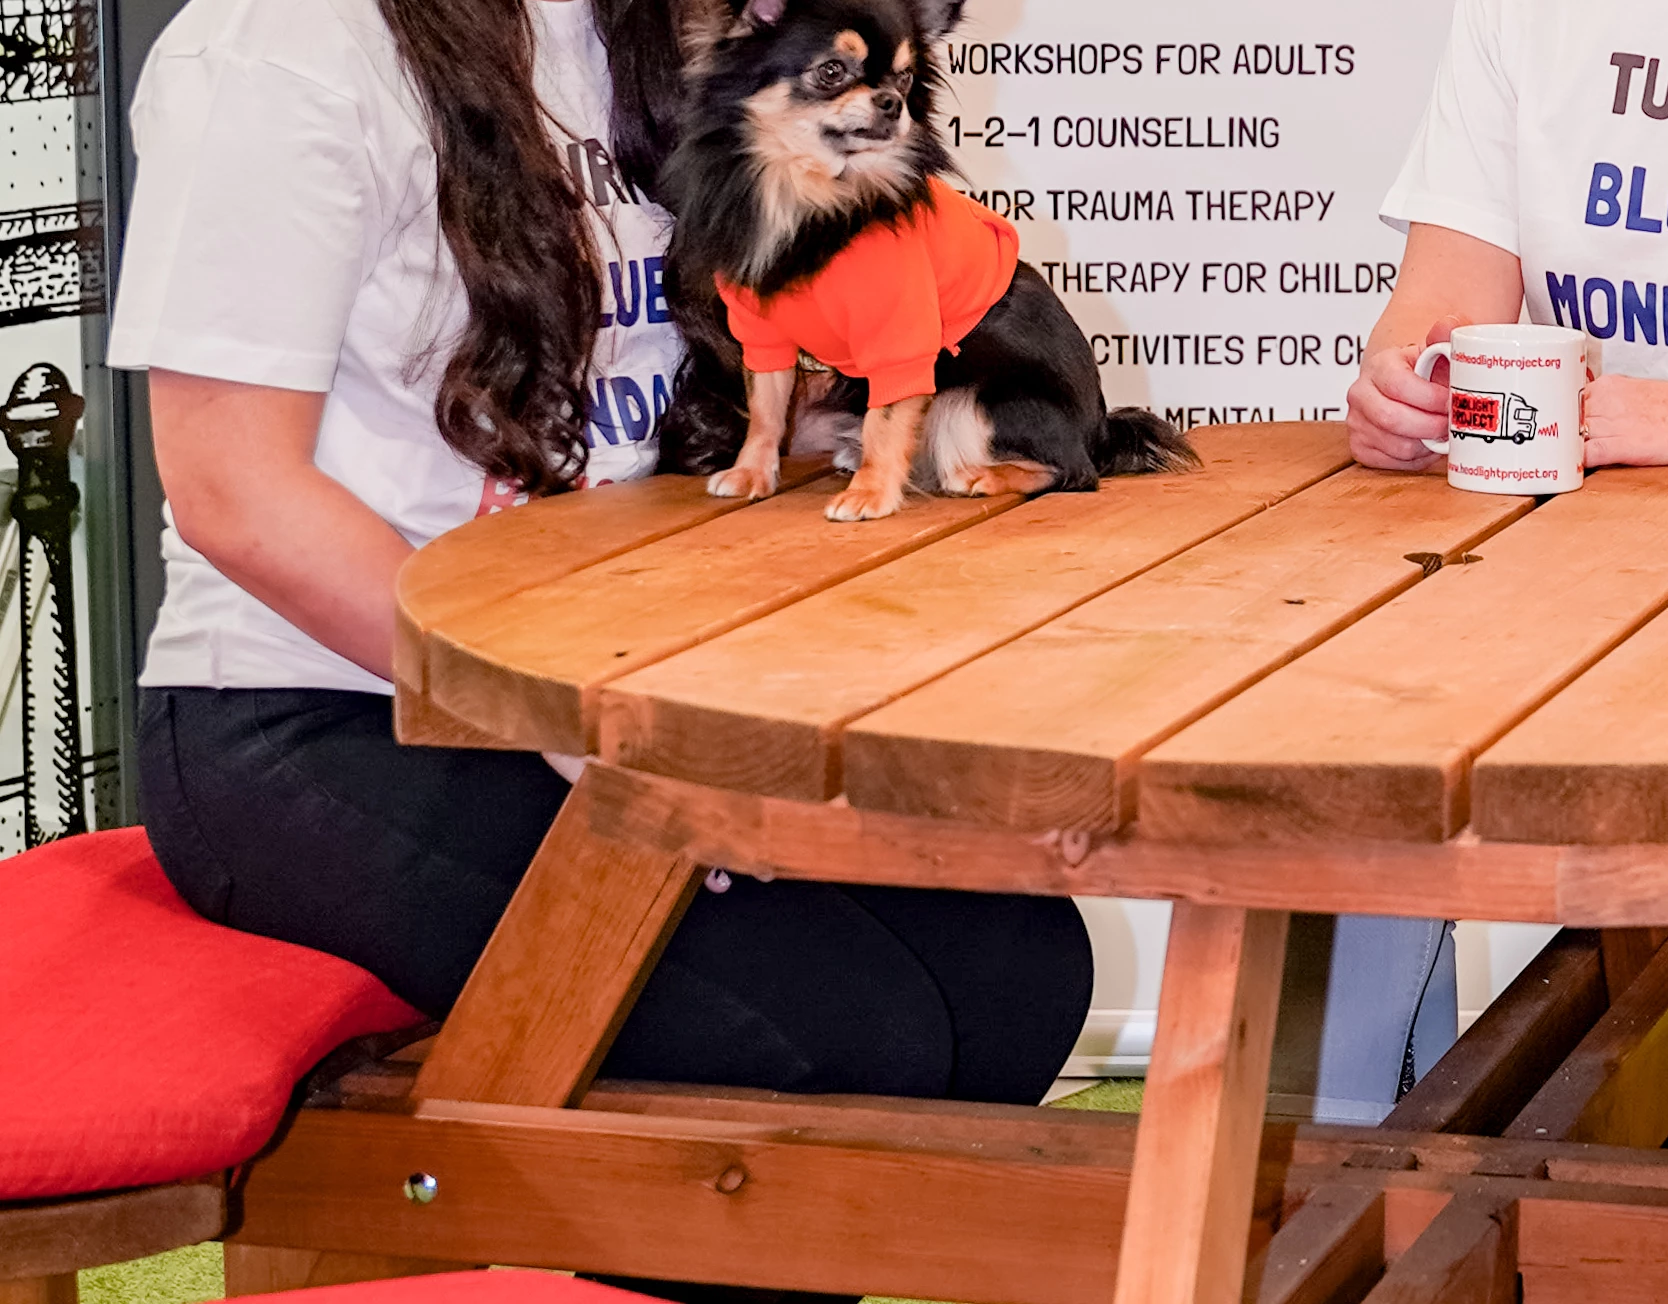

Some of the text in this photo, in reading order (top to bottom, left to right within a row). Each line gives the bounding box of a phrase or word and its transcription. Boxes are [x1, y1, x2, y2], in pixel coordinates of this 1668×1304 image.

[948, 43, 1356, 75] WORKSHOPS FOR ADULTS
[1053, 116, 1281, 149] COUNSELLING
[1047, 190, 1174, 221] TRAUMA
[1185, 190, 1336, 221] THERAPY
[1041, 261, 1397, 293] THERAPY FOR CHILDR
[1091, 334, 1245, 365] CTIVITIES
[1257, 334, 1322, 365] FOR
